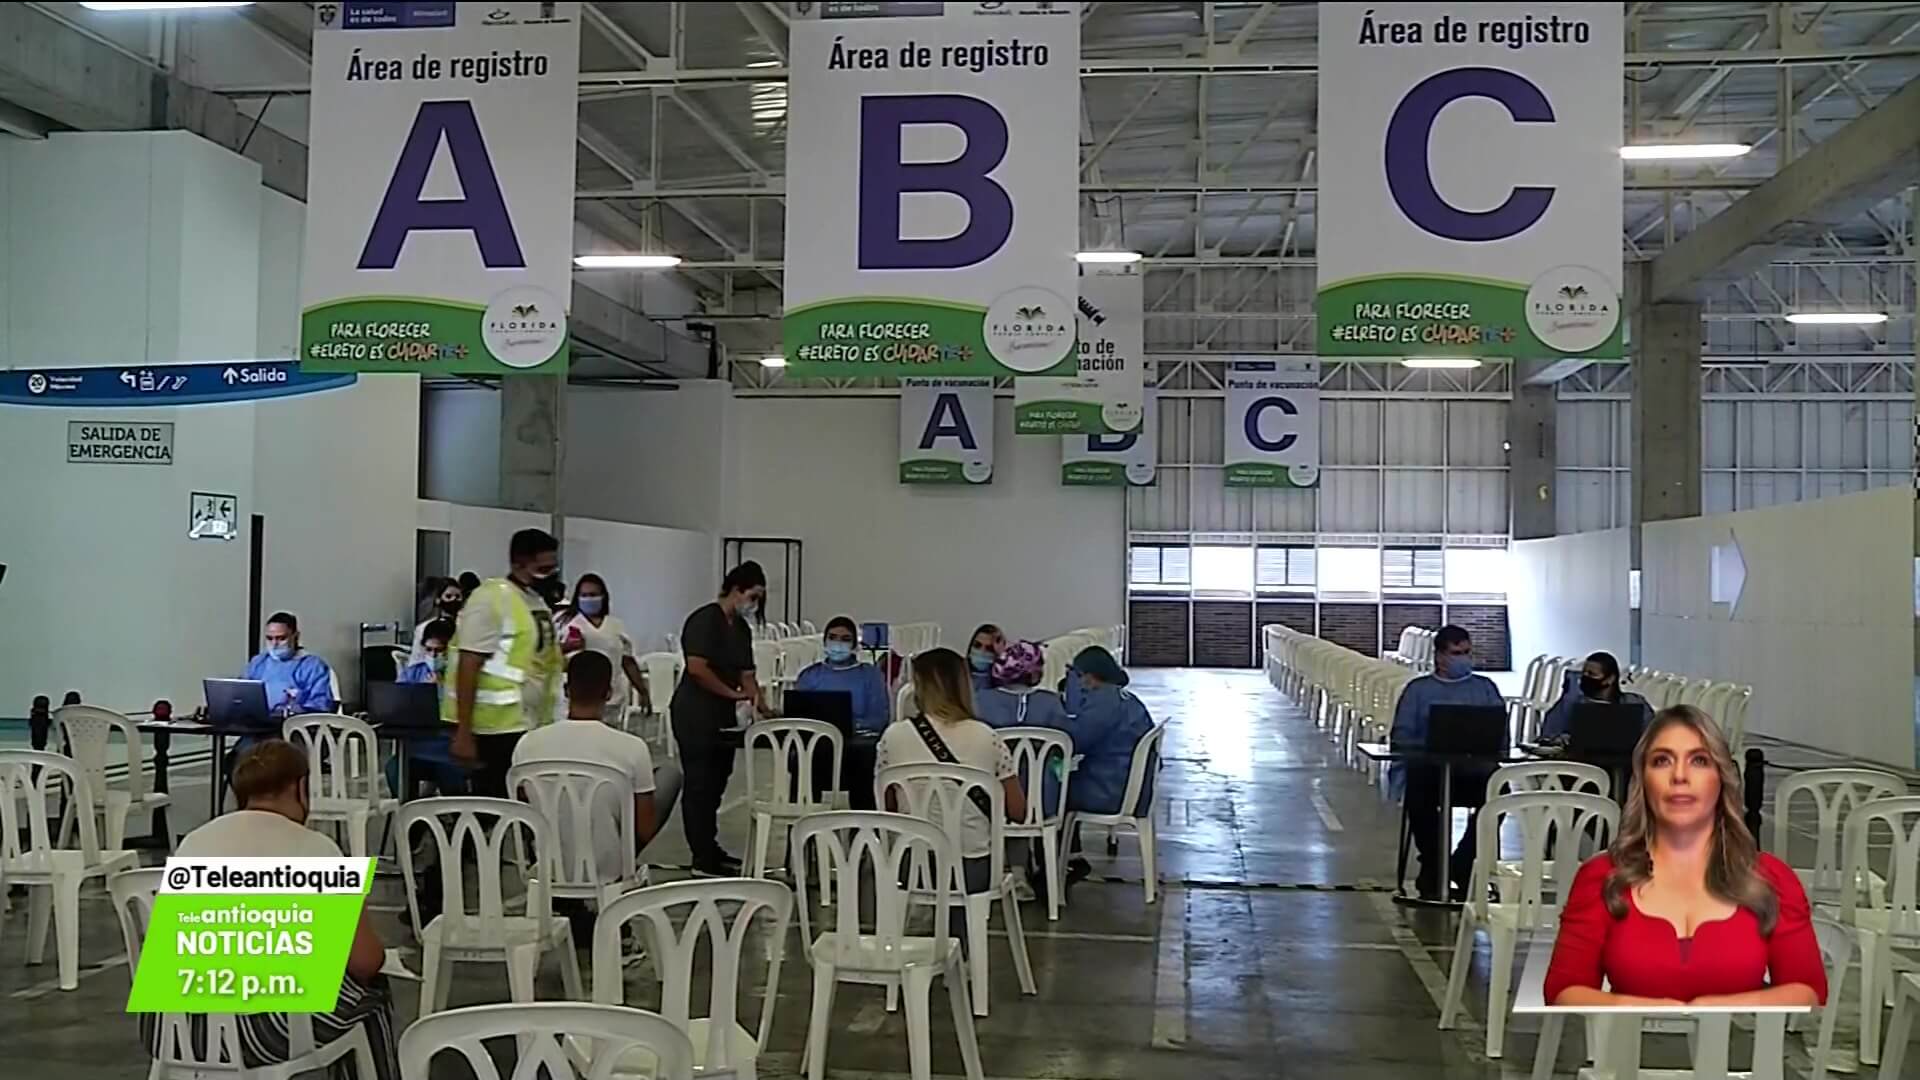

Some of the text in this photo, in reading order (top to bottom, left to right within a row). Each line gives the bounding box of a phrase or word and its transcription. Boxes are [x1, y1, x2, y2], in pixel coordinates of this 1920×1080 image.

[1359, 10, 1589, 49] Área de registro
[829, 36, 1049, 73] Área de registro
[347, 48, 547, 83] Área de registro
[1385, 67, 1556, 241] C
[357, 100, 526, 269] A
[858, 94, 1013, 269] B
[1356, 302, 1471, 319] PARA FLORECER
[1536, 303, 1608, 311] FLORIDA
[331, 322, 431, 338] PARA FLORECER
[821, 322, 931, 339] PARA FLORECER
[993, 324, 1065, 332] FLORIDA
[1332, 325, 1396, 342] #ELRETO
[1401, 325, 1418, 342] ES
[310, 343, 366, 359] #ELRETO
[369, 343, 385, 359] ES
[798, 344, 860, 361] #ELRETO
[864, 344, 880, 361] ES
[1096, 338, 1115, 354] de
[240, 368, 287, 383] Salida
[918, 393, 978, 450] A
[1244, 396, 1298, 452] C
[81, 427, 161, 441] SALIDA DE
[70, 444, 172, 460] EMERGENCIA
